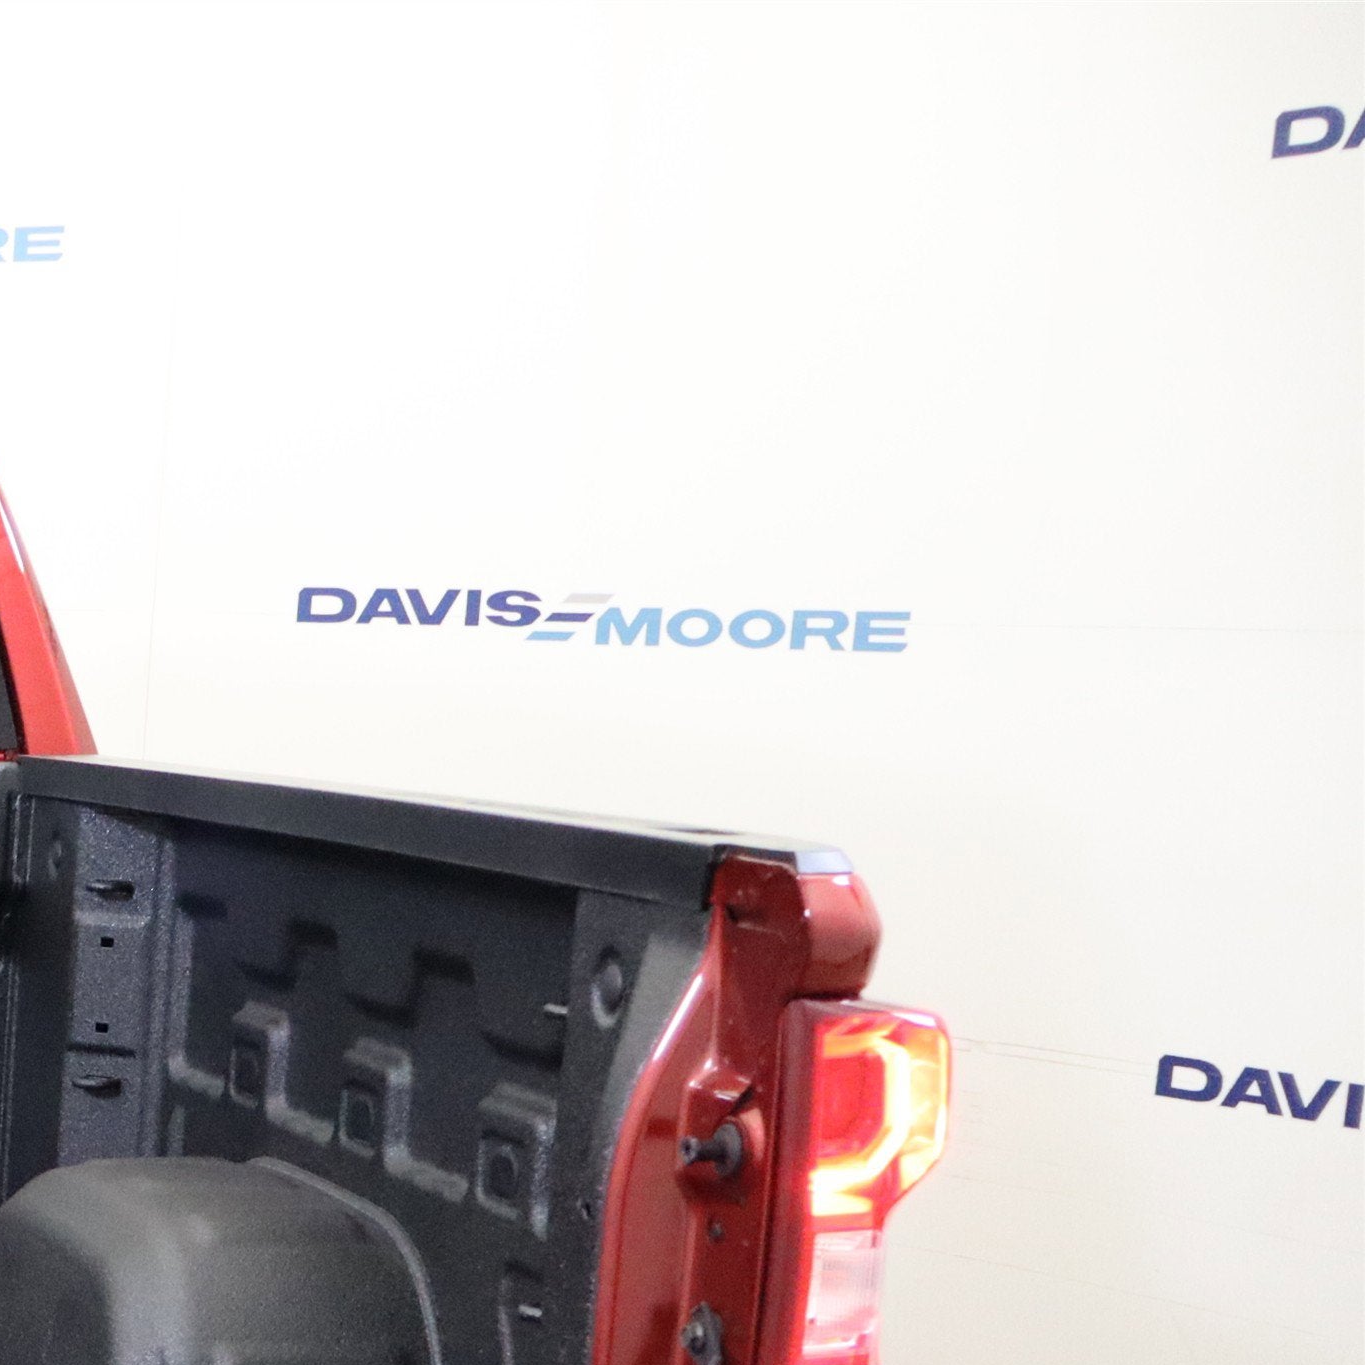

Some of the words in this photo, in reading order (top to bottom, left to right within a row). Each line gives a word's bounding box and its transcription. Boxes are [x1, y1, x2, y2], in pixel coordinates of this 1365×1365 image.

[296, 587, 541, 627] DAVIS
[595, 607, 910, 652] MOORE
[1155, 1054, 1365, 1129] DAVI
